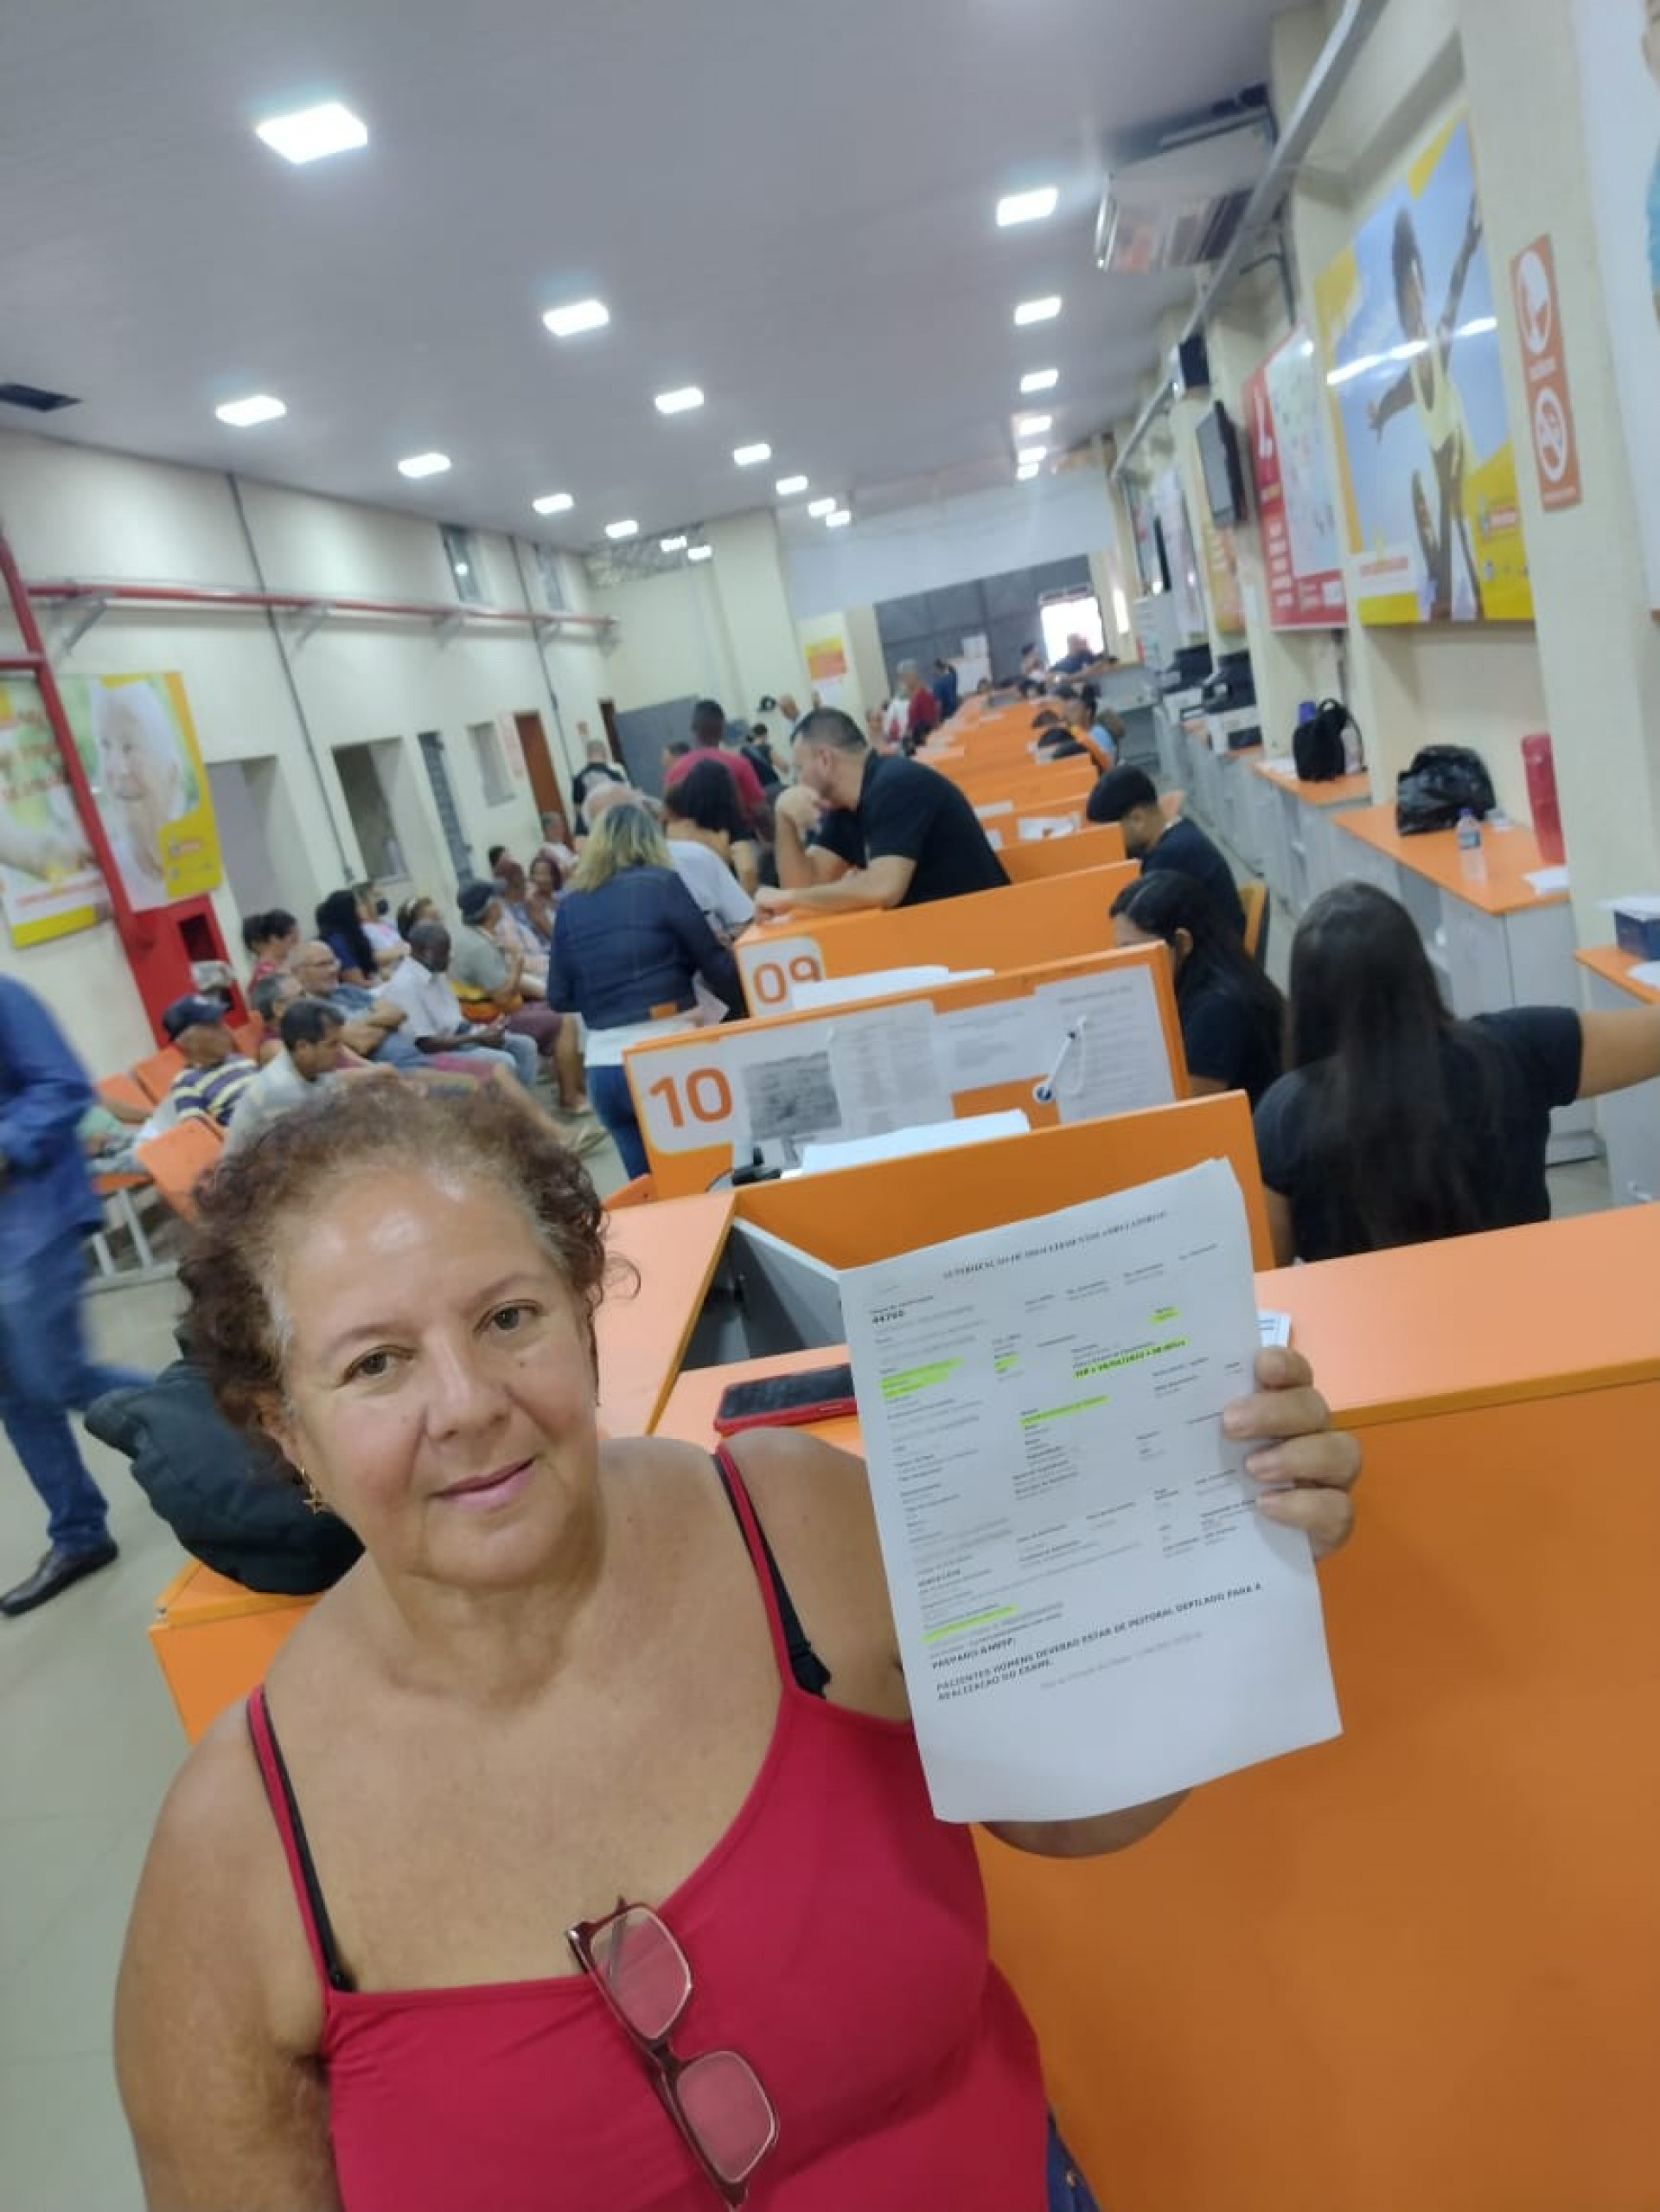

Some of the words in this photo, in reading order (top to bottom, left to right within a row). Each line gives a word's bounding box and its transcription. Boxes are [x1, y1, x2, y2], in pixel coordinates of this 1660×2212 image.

[752, 956, 820, 1004] 09
[649, 1068, 732, 1128] 10
[1227, 1584, 1253, 1599] PARA
